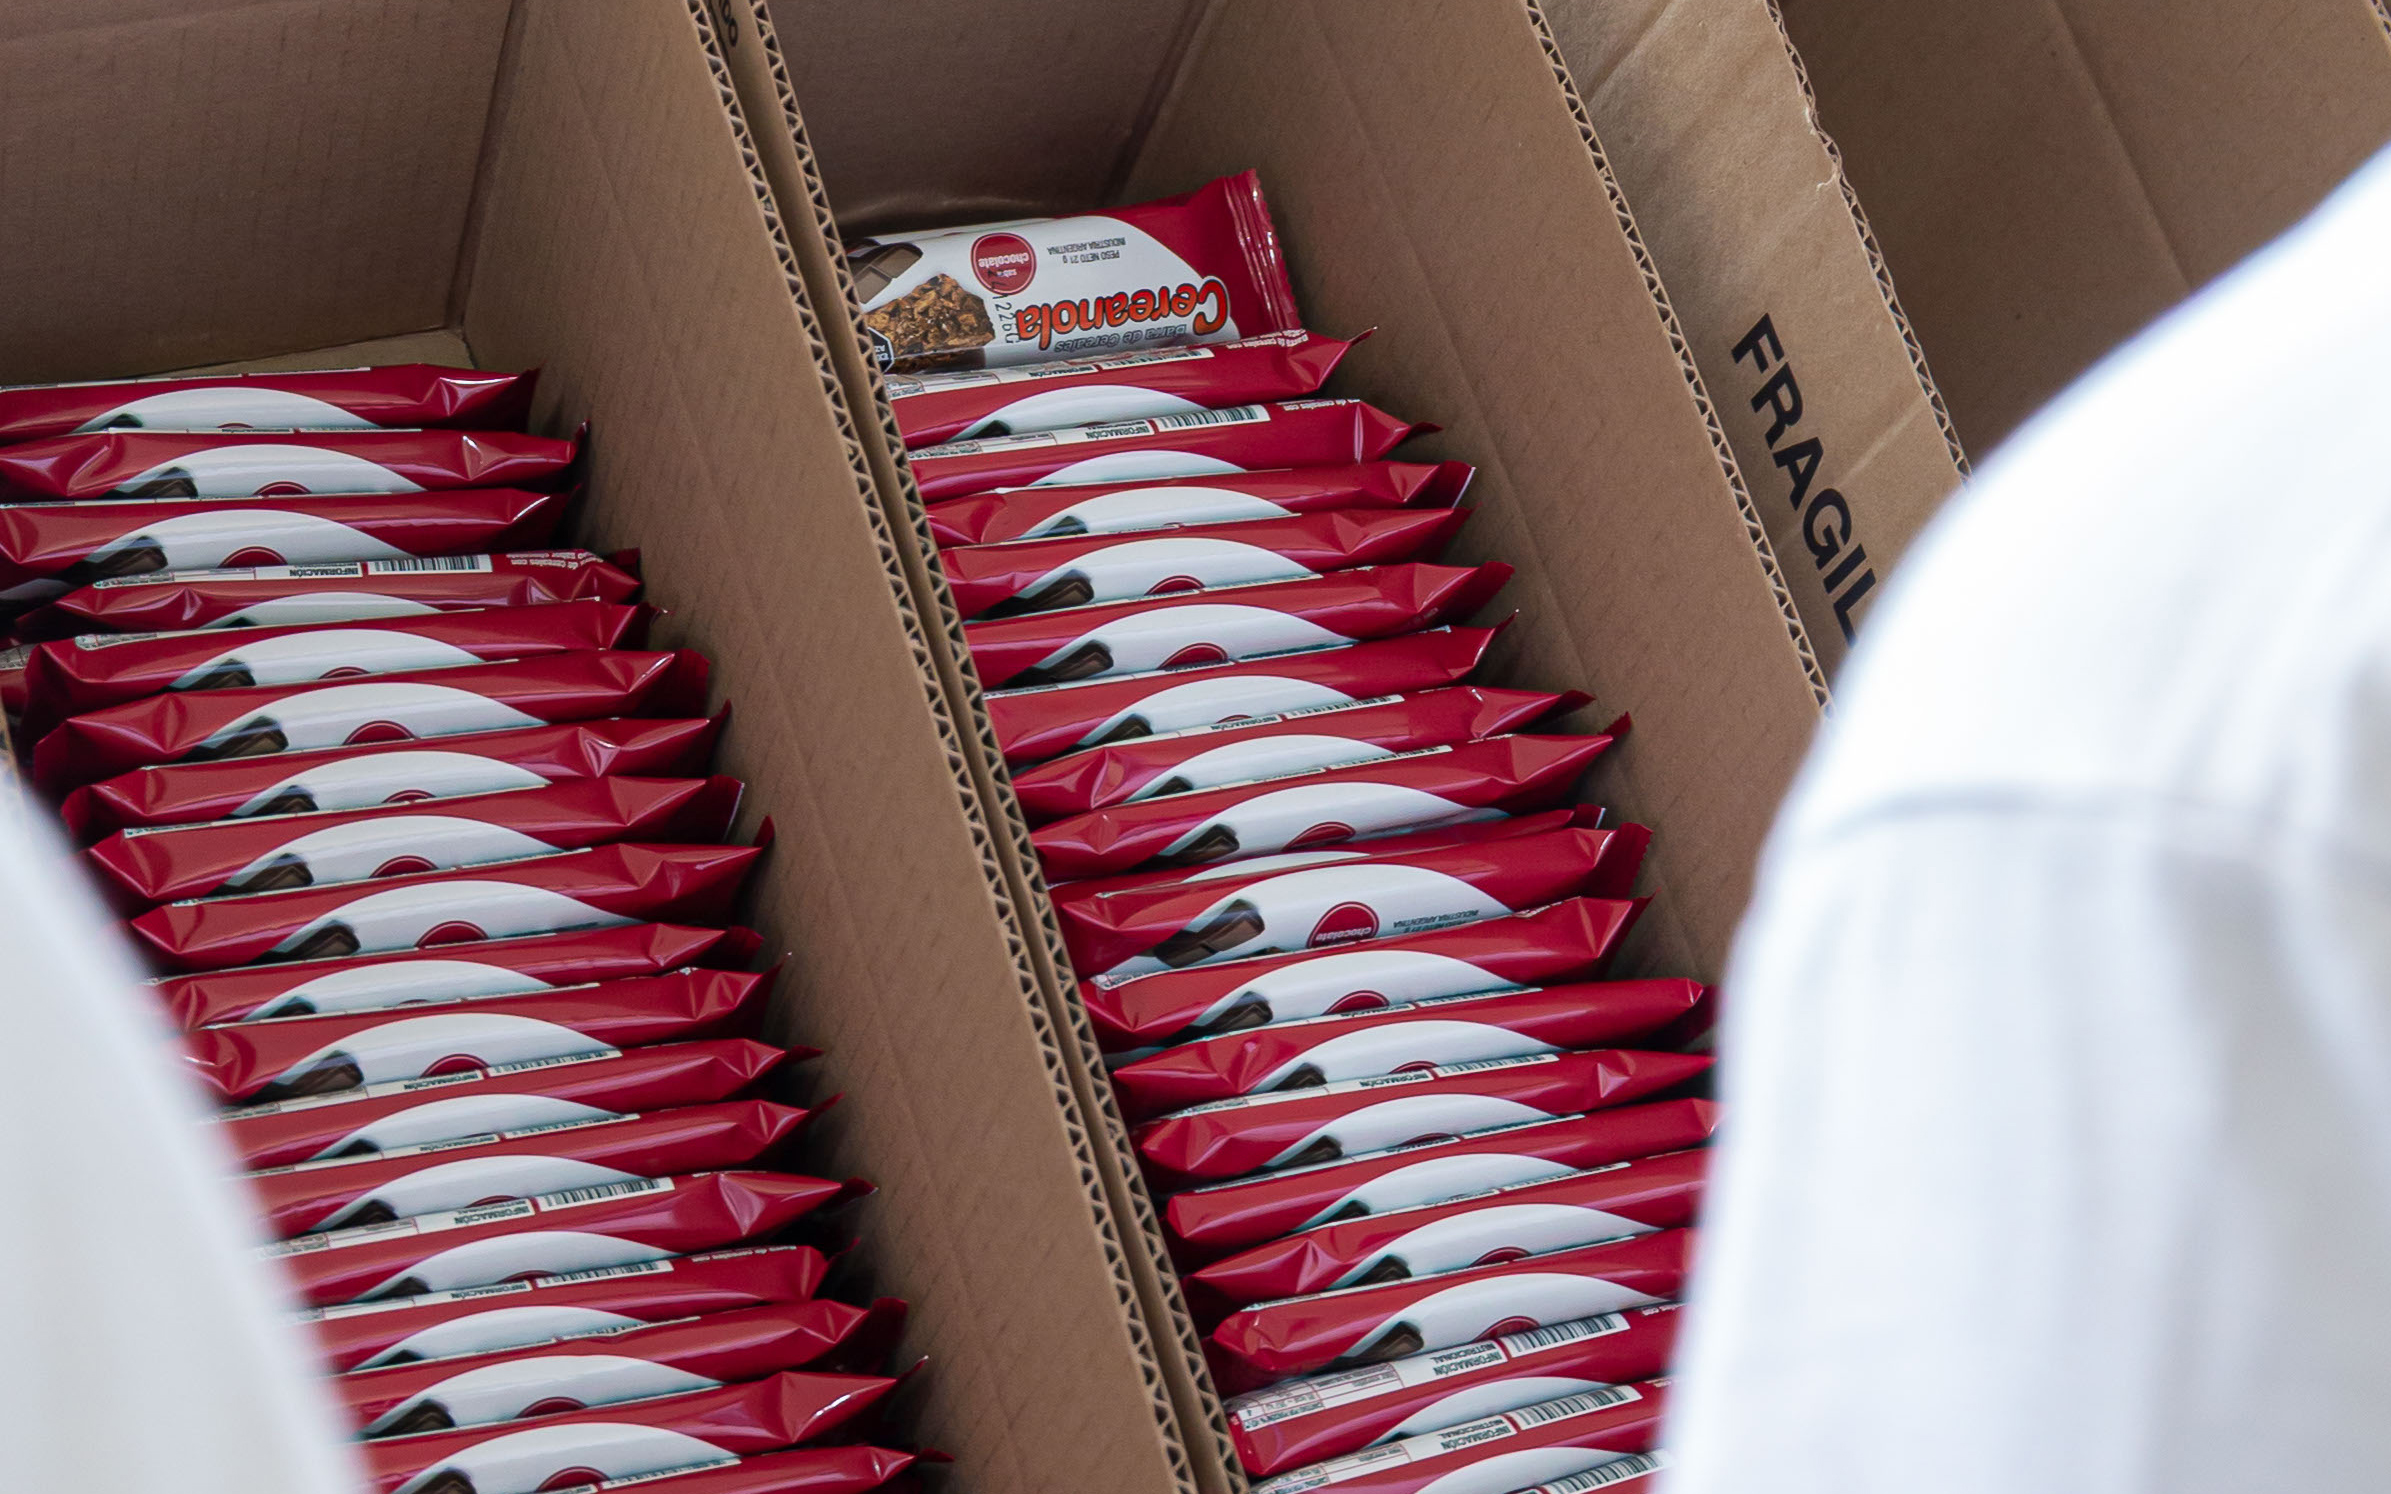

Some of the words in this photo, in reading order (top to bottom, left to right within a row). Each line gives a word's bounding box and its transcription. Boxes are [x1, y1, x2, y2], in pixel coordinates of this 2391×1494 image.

[1046, 242, 1088, 255] ARGENTINA
[1100, 249, 1120, 260] PESO
[978, 252, 1029, 268] chocolate
[1080, 252, 1100, 263] NETO
[1015, 279, 1228, 351] Cereanola
[1054, 333, 1121, 352] Cereales
[1122, 330, 1143, 343] de
[1085, 425, 1150, 440] INFORMACIÓN
[1732, 312, 1877, 648] FRAGIL
[289, 567, 359, 578] INFORMACIÓN
[454, 1205, 530, 1224] INFORMACIÓN
[1430, 1342, 1496, 1364] NUTRICIONAL
[1433, 1351, 1503, 1376] INFORMACIÓN
[1440, 1425, 1512, 1450] INFORMACIÓN
